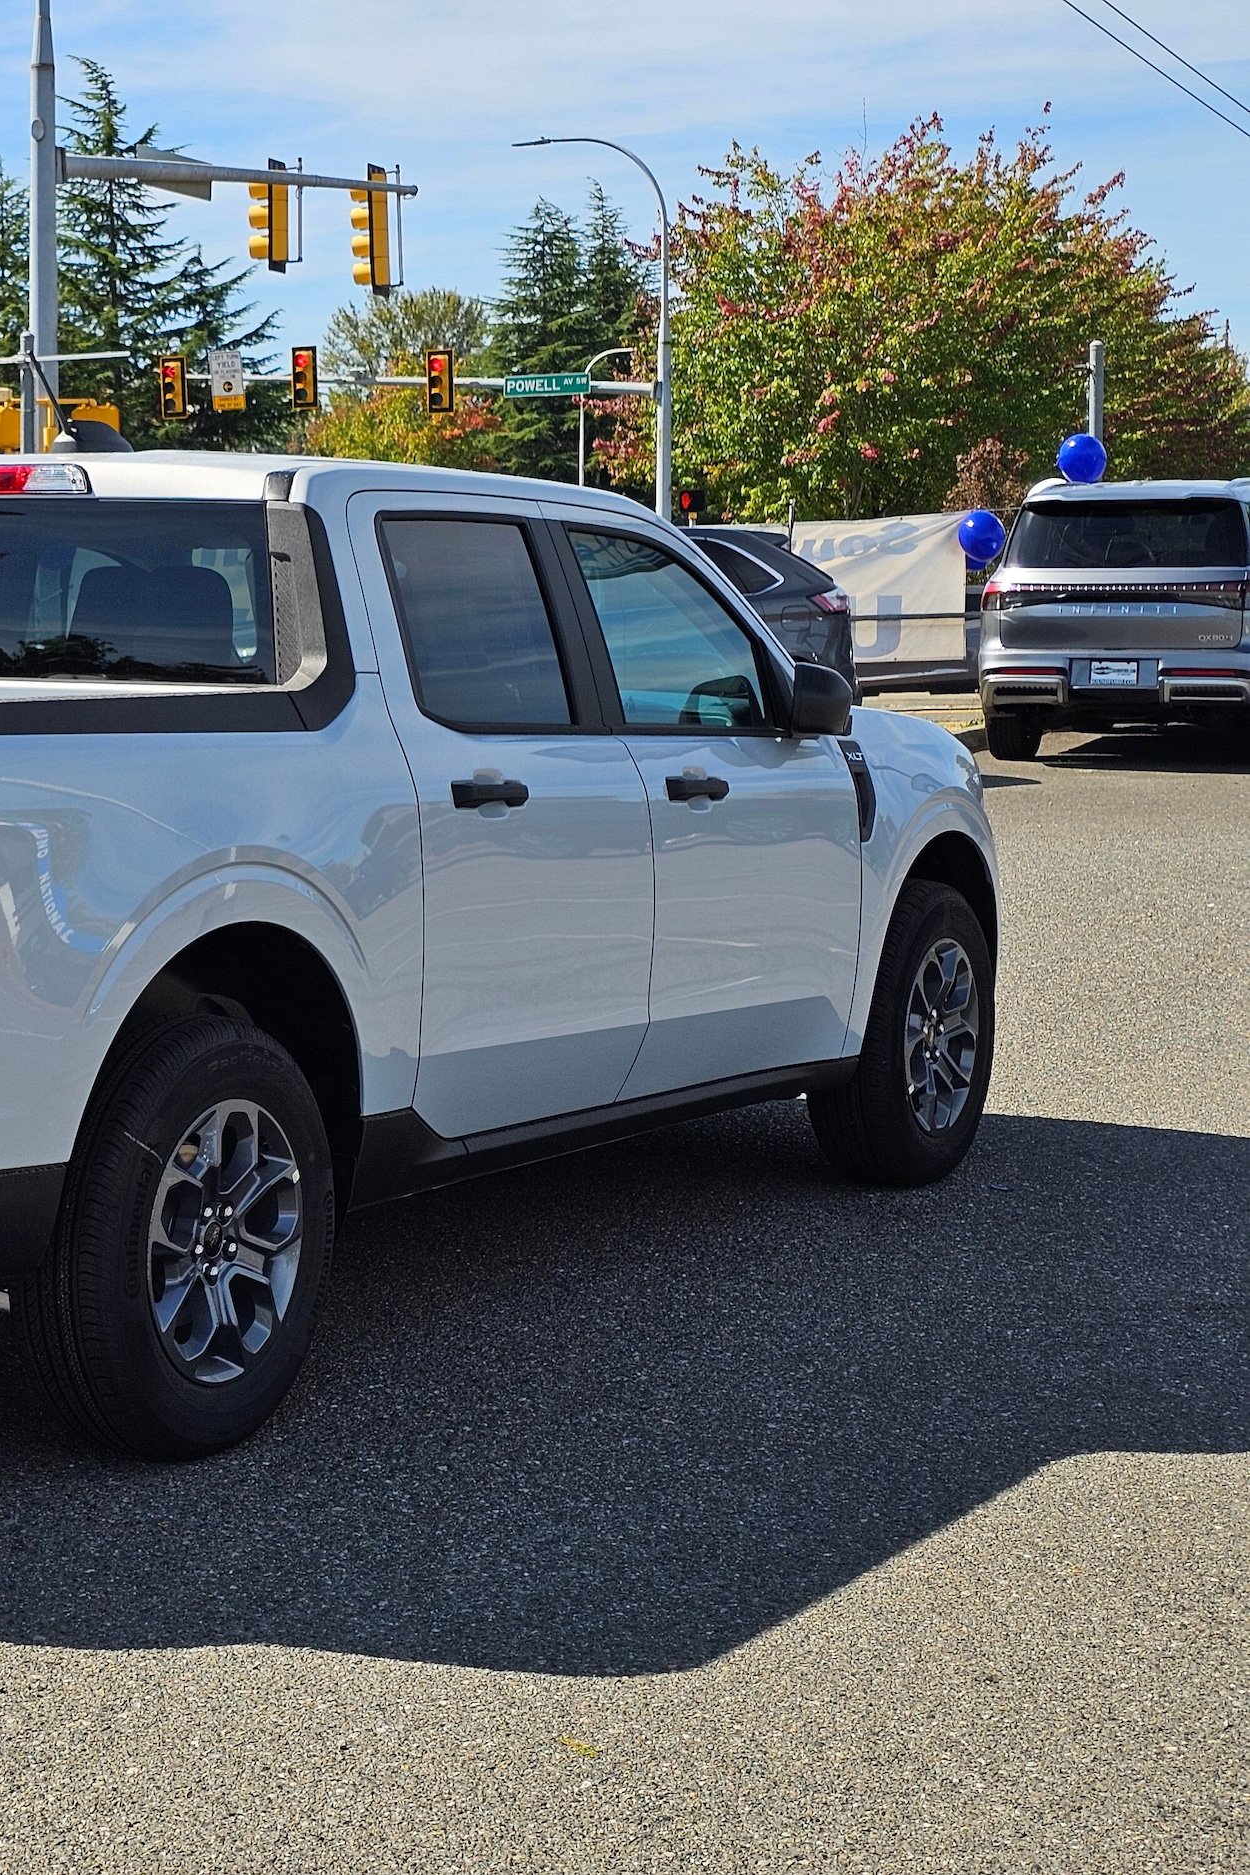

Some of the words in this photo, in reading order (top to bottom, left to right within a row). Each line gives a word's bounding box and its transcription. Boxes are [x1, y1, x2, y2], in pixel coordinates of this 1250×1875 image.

[506, 378, 561, 393] POWELL
[575, 376, 588, 385] SW
[1057, 605, 1178, 614] INFINITI
[845, 752, 863, 761] XLT
